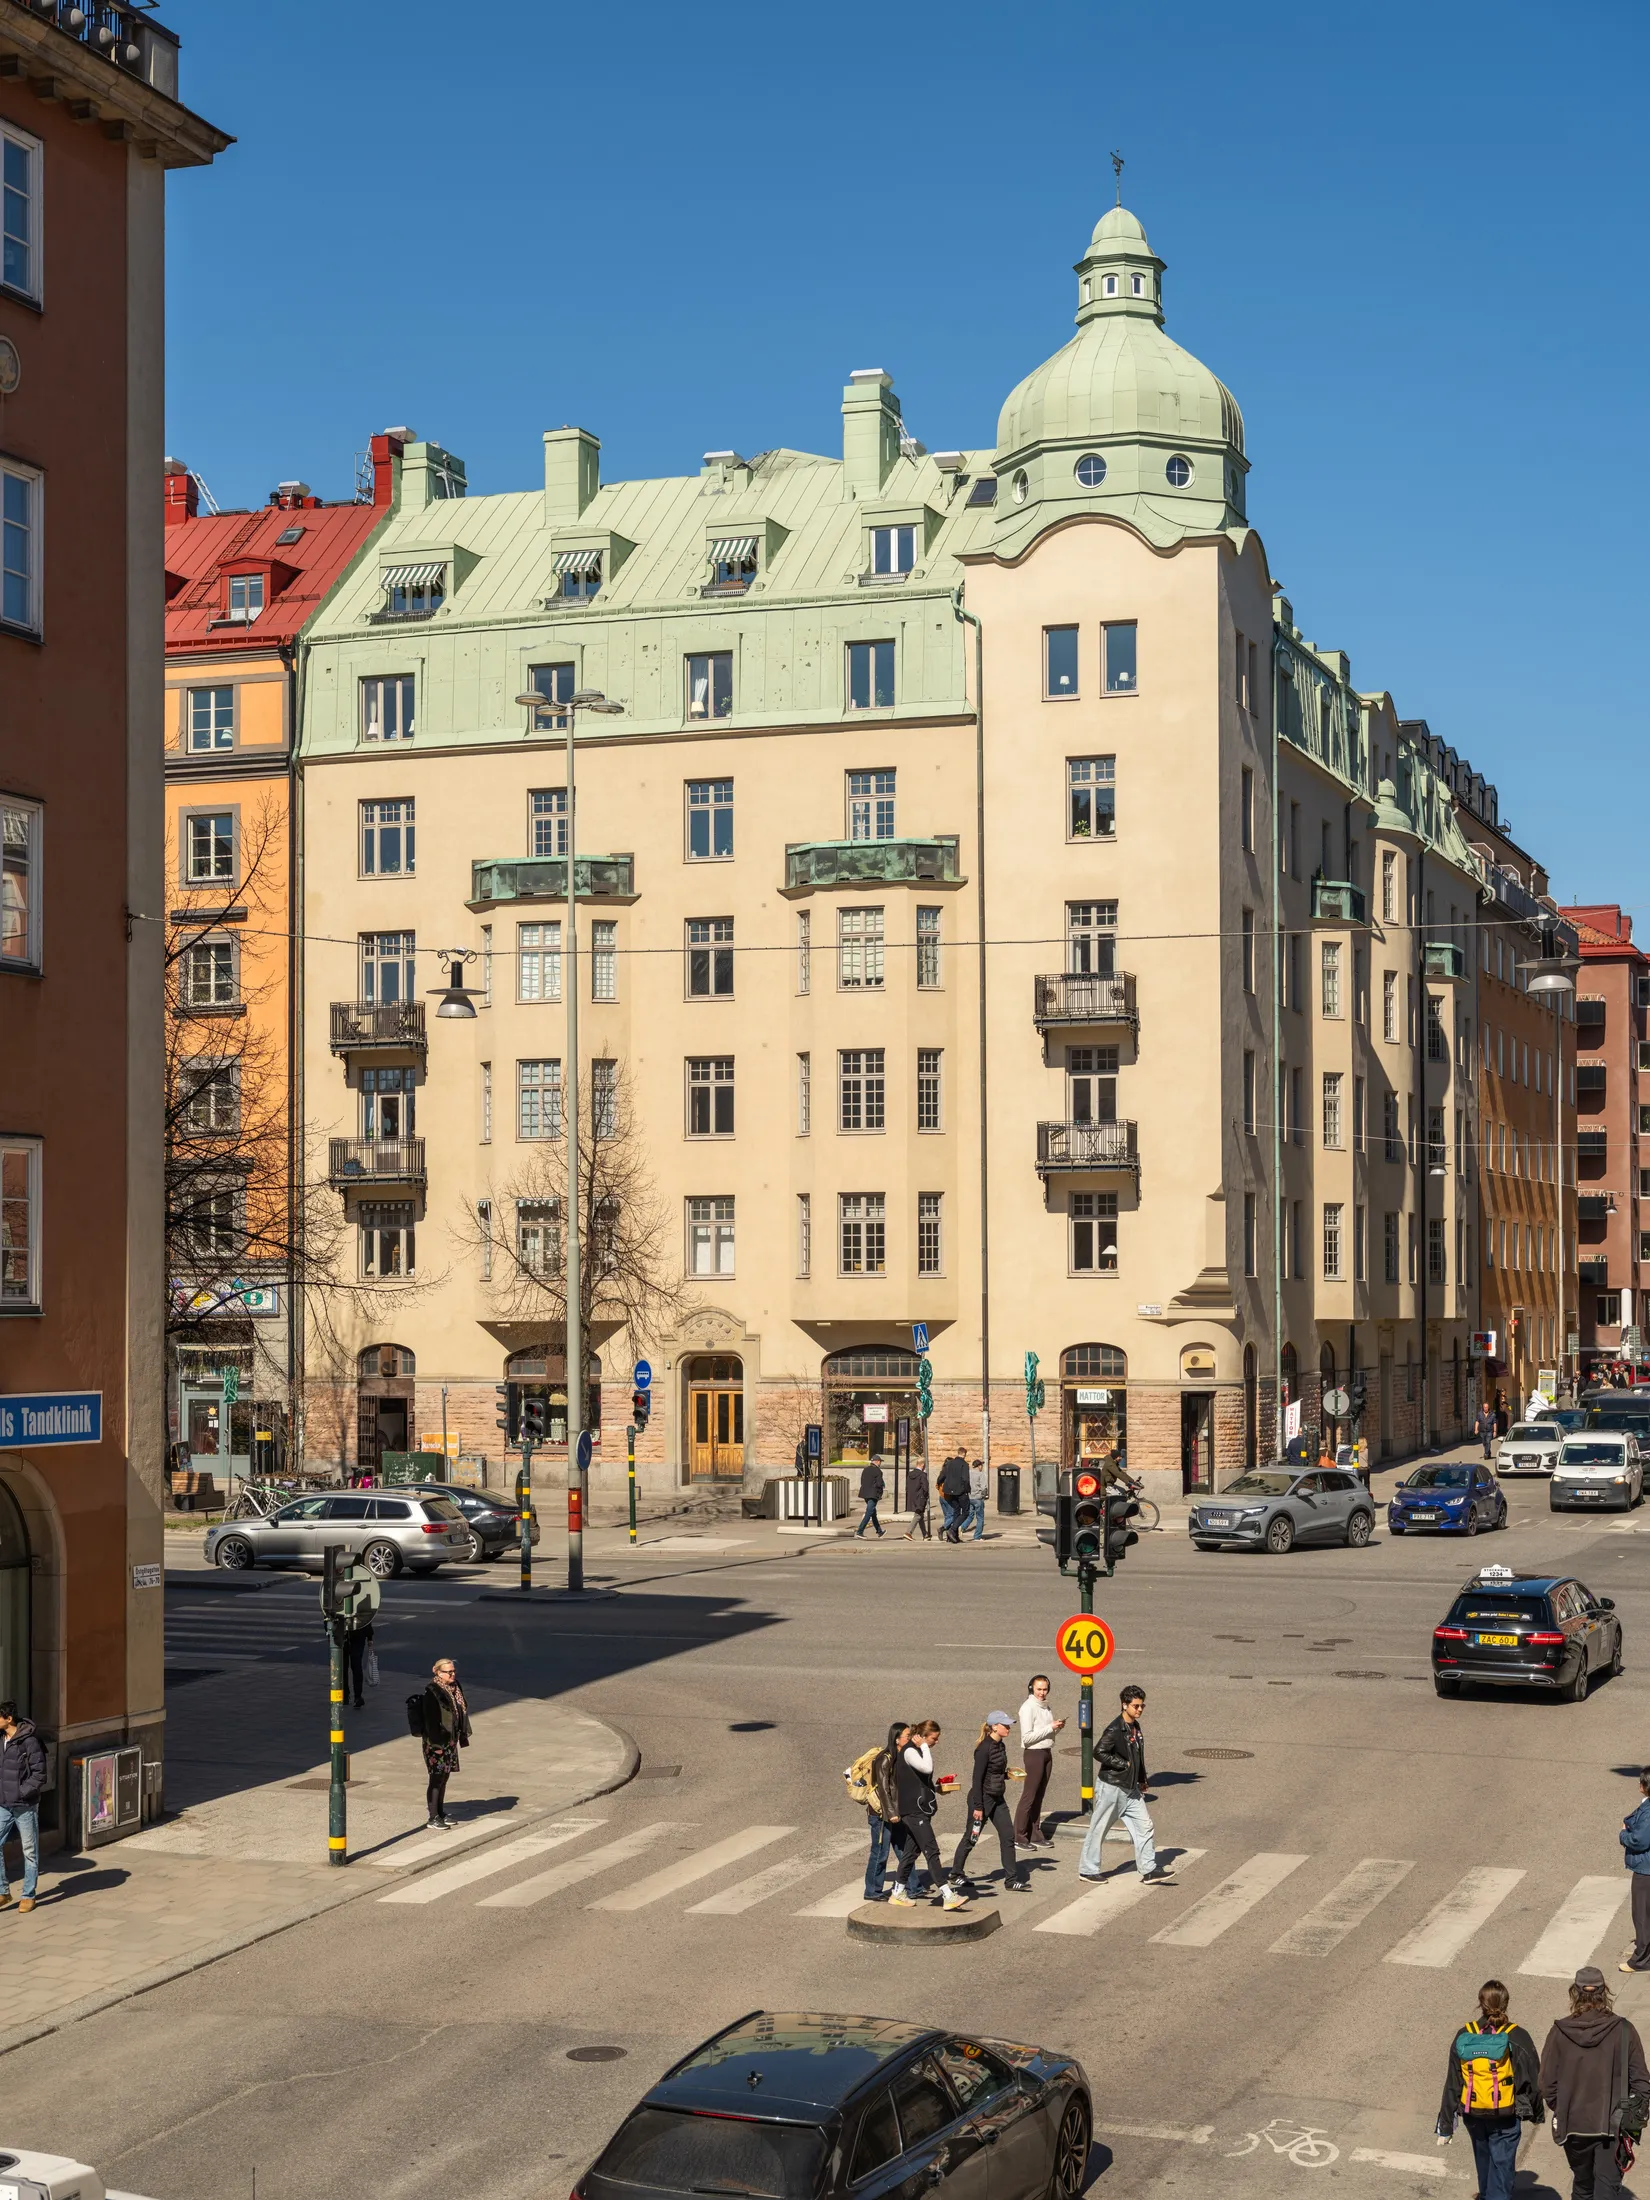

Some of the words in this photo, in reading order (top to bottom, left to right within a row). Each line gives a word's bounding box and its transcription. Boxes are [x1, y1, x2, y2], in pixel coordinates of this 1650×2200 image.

[1079, 1391, 1105, 1401] MATTOR
[21, 1404, 92, 1436] Tandklinik
[1065, 1629, 1106, 1659] 40
[1481, 1635, 1497, 1644] ZAC
[1499, 1636, 1515, 1645] 60J
